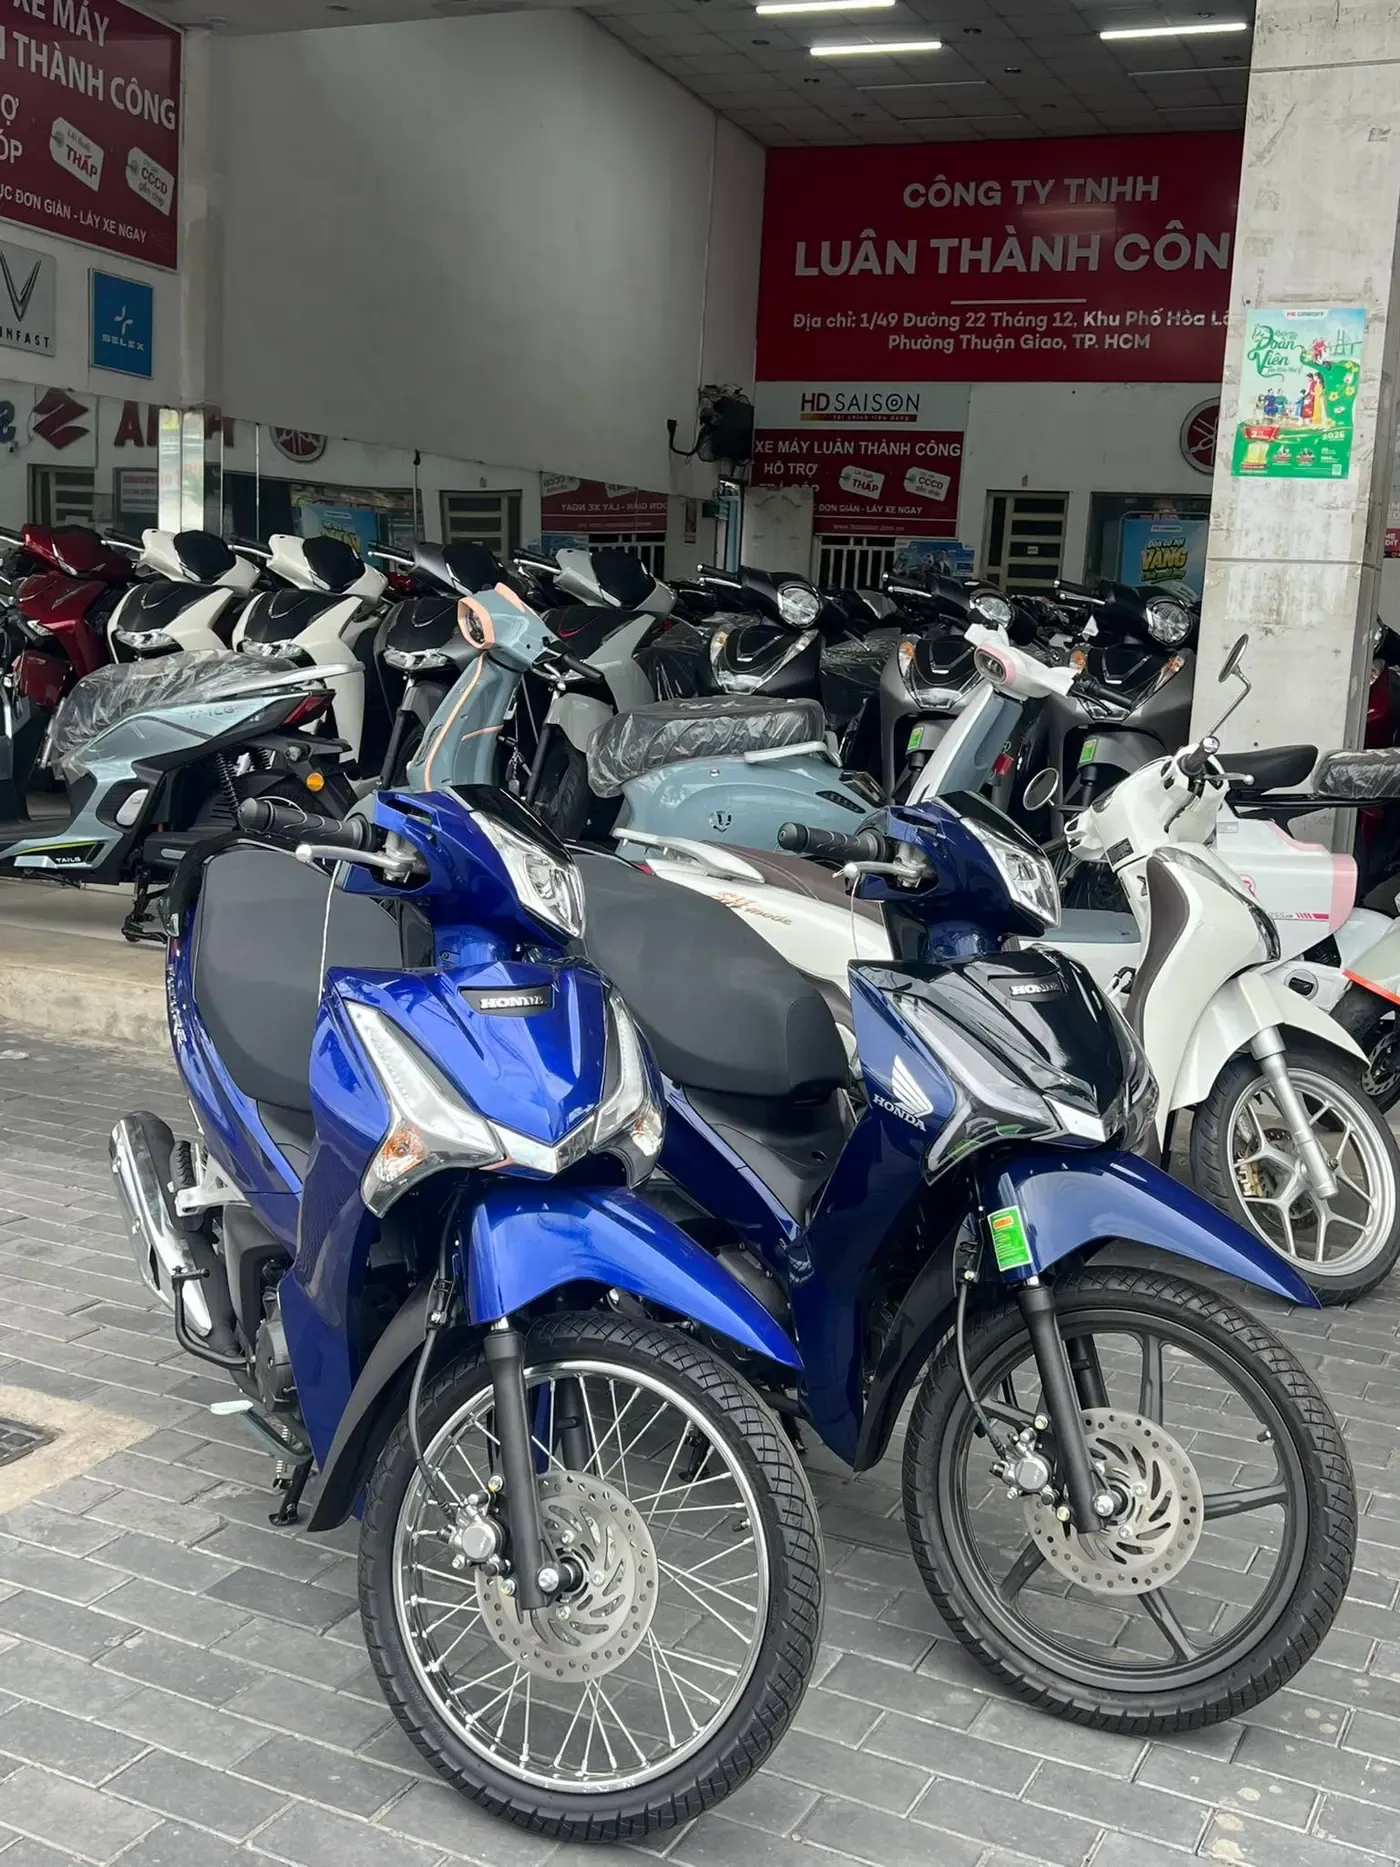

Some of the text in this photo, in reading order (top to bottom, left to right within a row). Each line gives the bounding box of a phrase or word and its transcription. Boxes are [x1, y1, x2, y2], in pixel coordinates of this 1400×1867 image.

[53, 0, 110, 47] MÁY
[12, 31, 104, 101] THÀNH
[110, 77, 175, 130] CÔNG
[141, 167, 168, 194] CCCD
[903, 174, 1160, 208] CÔNG TY TNHH
[16, 190, 41, 211] ĐƠN
[102, 216, 117, 236] XE
[118, 222, 148, 245] NGAY
[795, 228, 918, 276] LUÂN
[929, 225, 1101, 275] THÀNH
[793, 313, 822, 331] Địa
[826, 311, 856, 329] chỉ:
[859, 312, 899, 331] 1/49
[903, 312, 960, 332] Đường
[965, 312, 986, 328] 22
[990, 311, 1047, 332] Tháng
[1052, 311, 1077, 328] 12,
[1083, 311, 1120, 327] Khu
[1125, 307, 1163, 327] Phố
[1166, 309, 1205, 326] Hòa
[102, 334, 145, 351] SELEX
[888, 333, 1151, 354] Phường Thuận Giao, TP. HCM
[801, 393, 920, 412] HD SAISON
[755, 438, 961, 456] XE MÁY LUÂN THÀNH CÔNG
[788, 463, 818, 478] TRỢ
[918, 476, 944, 490] CCCD
[885, 506, 897, 514] XE
[897, 506, 923, 515] NGAY
[872, 1093, 927, 1132] HONDA
